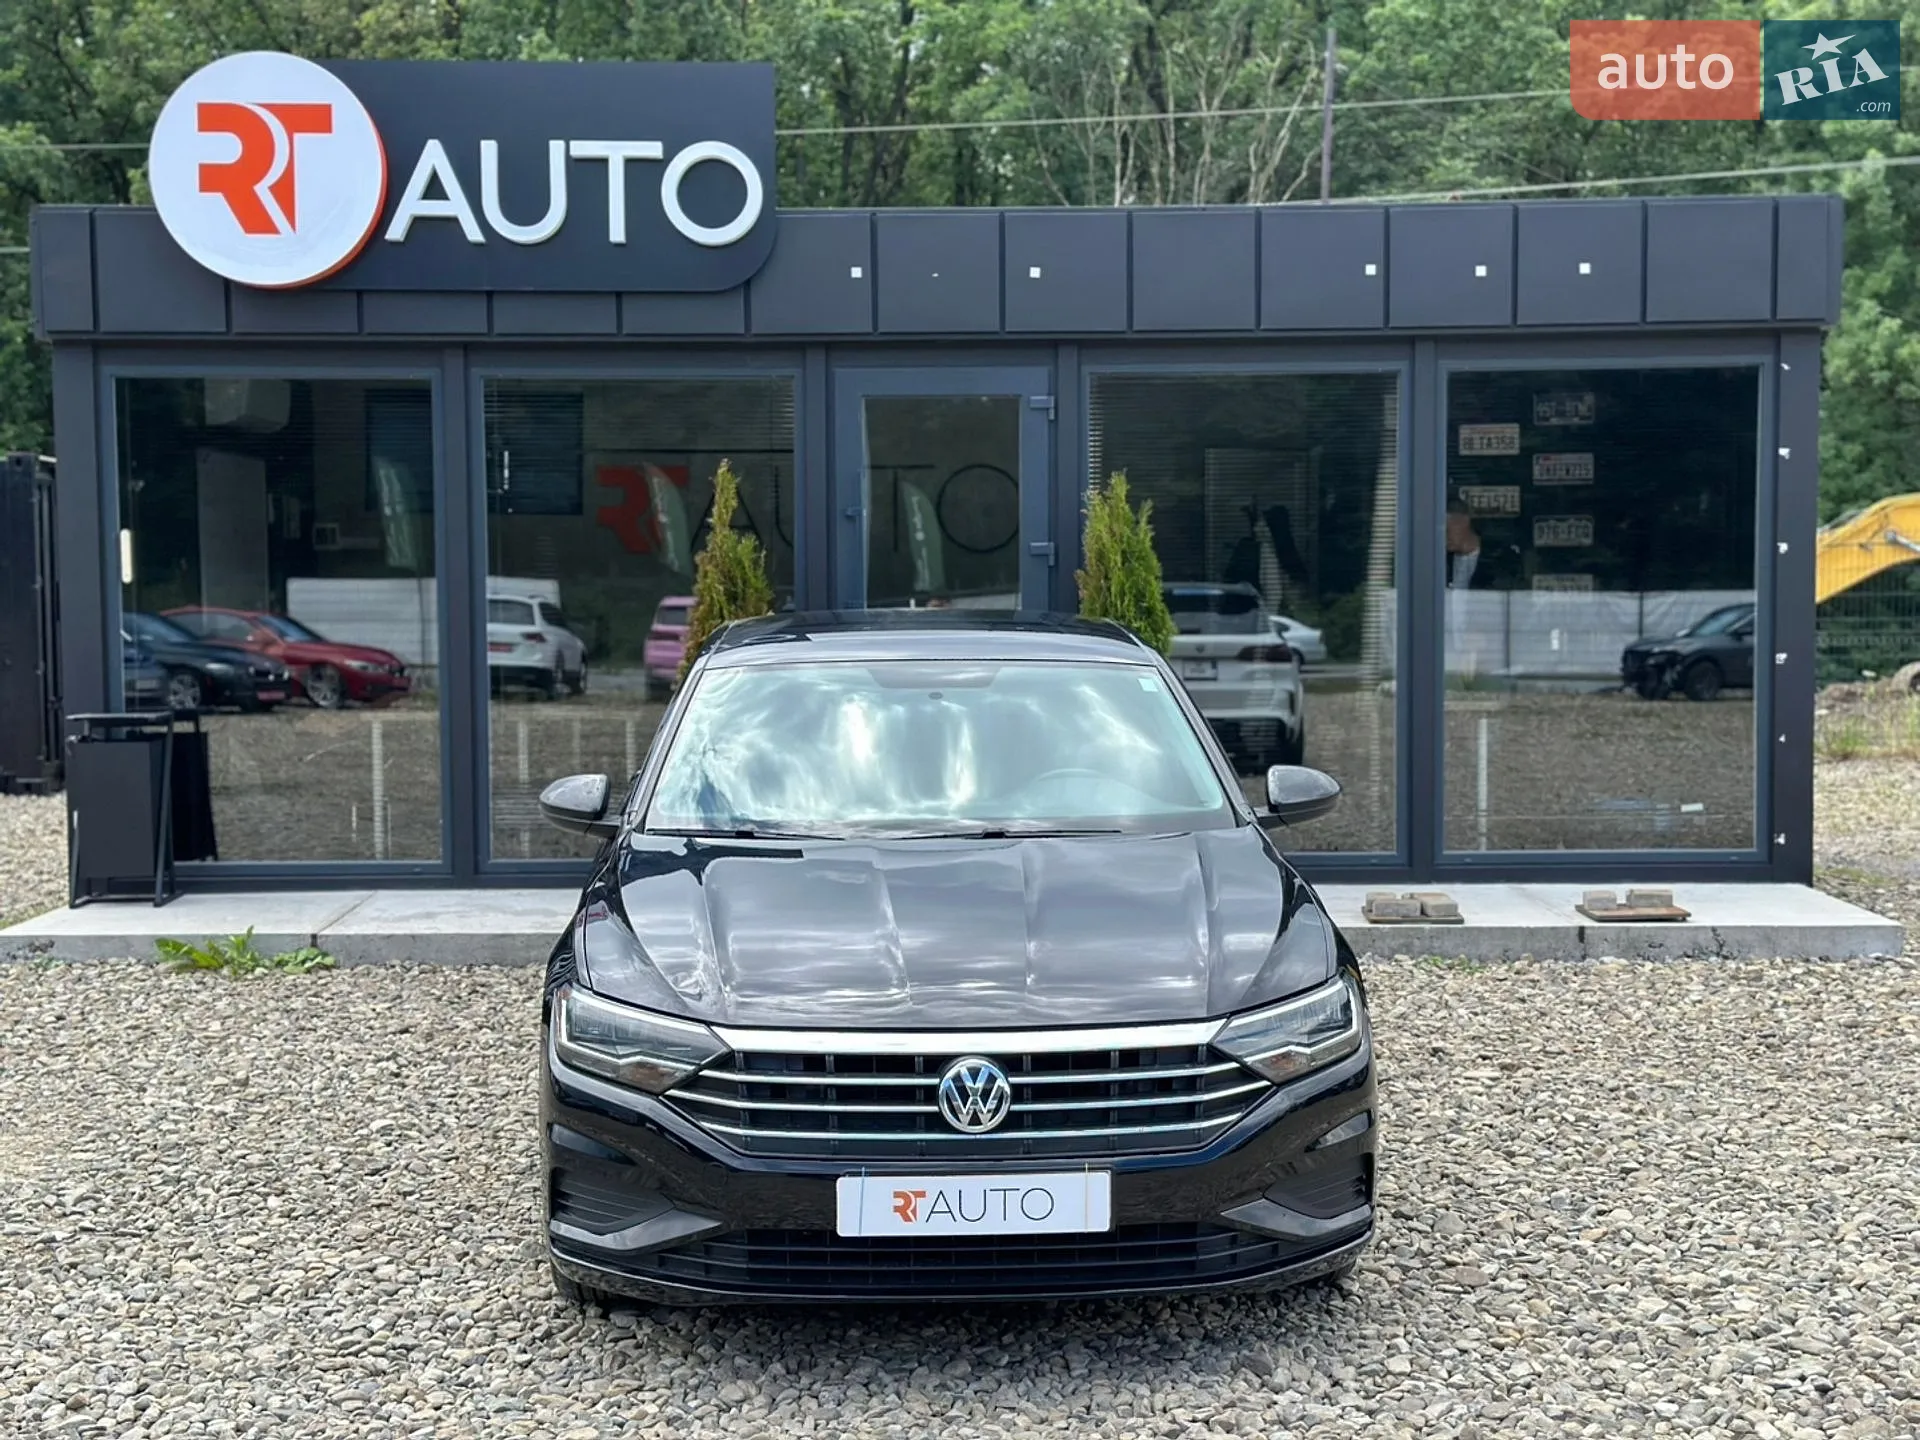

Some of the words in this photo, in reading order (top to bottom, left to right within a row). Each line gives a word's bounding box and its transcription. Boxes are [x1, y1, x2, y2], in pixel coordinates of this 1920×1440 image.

[197, 102, 333, 236] RT
[384, 138, 764, 247] AUTO
[893, 1190, 927, 1223] RT
[925, 1187, 1055, 1223] AUTO
